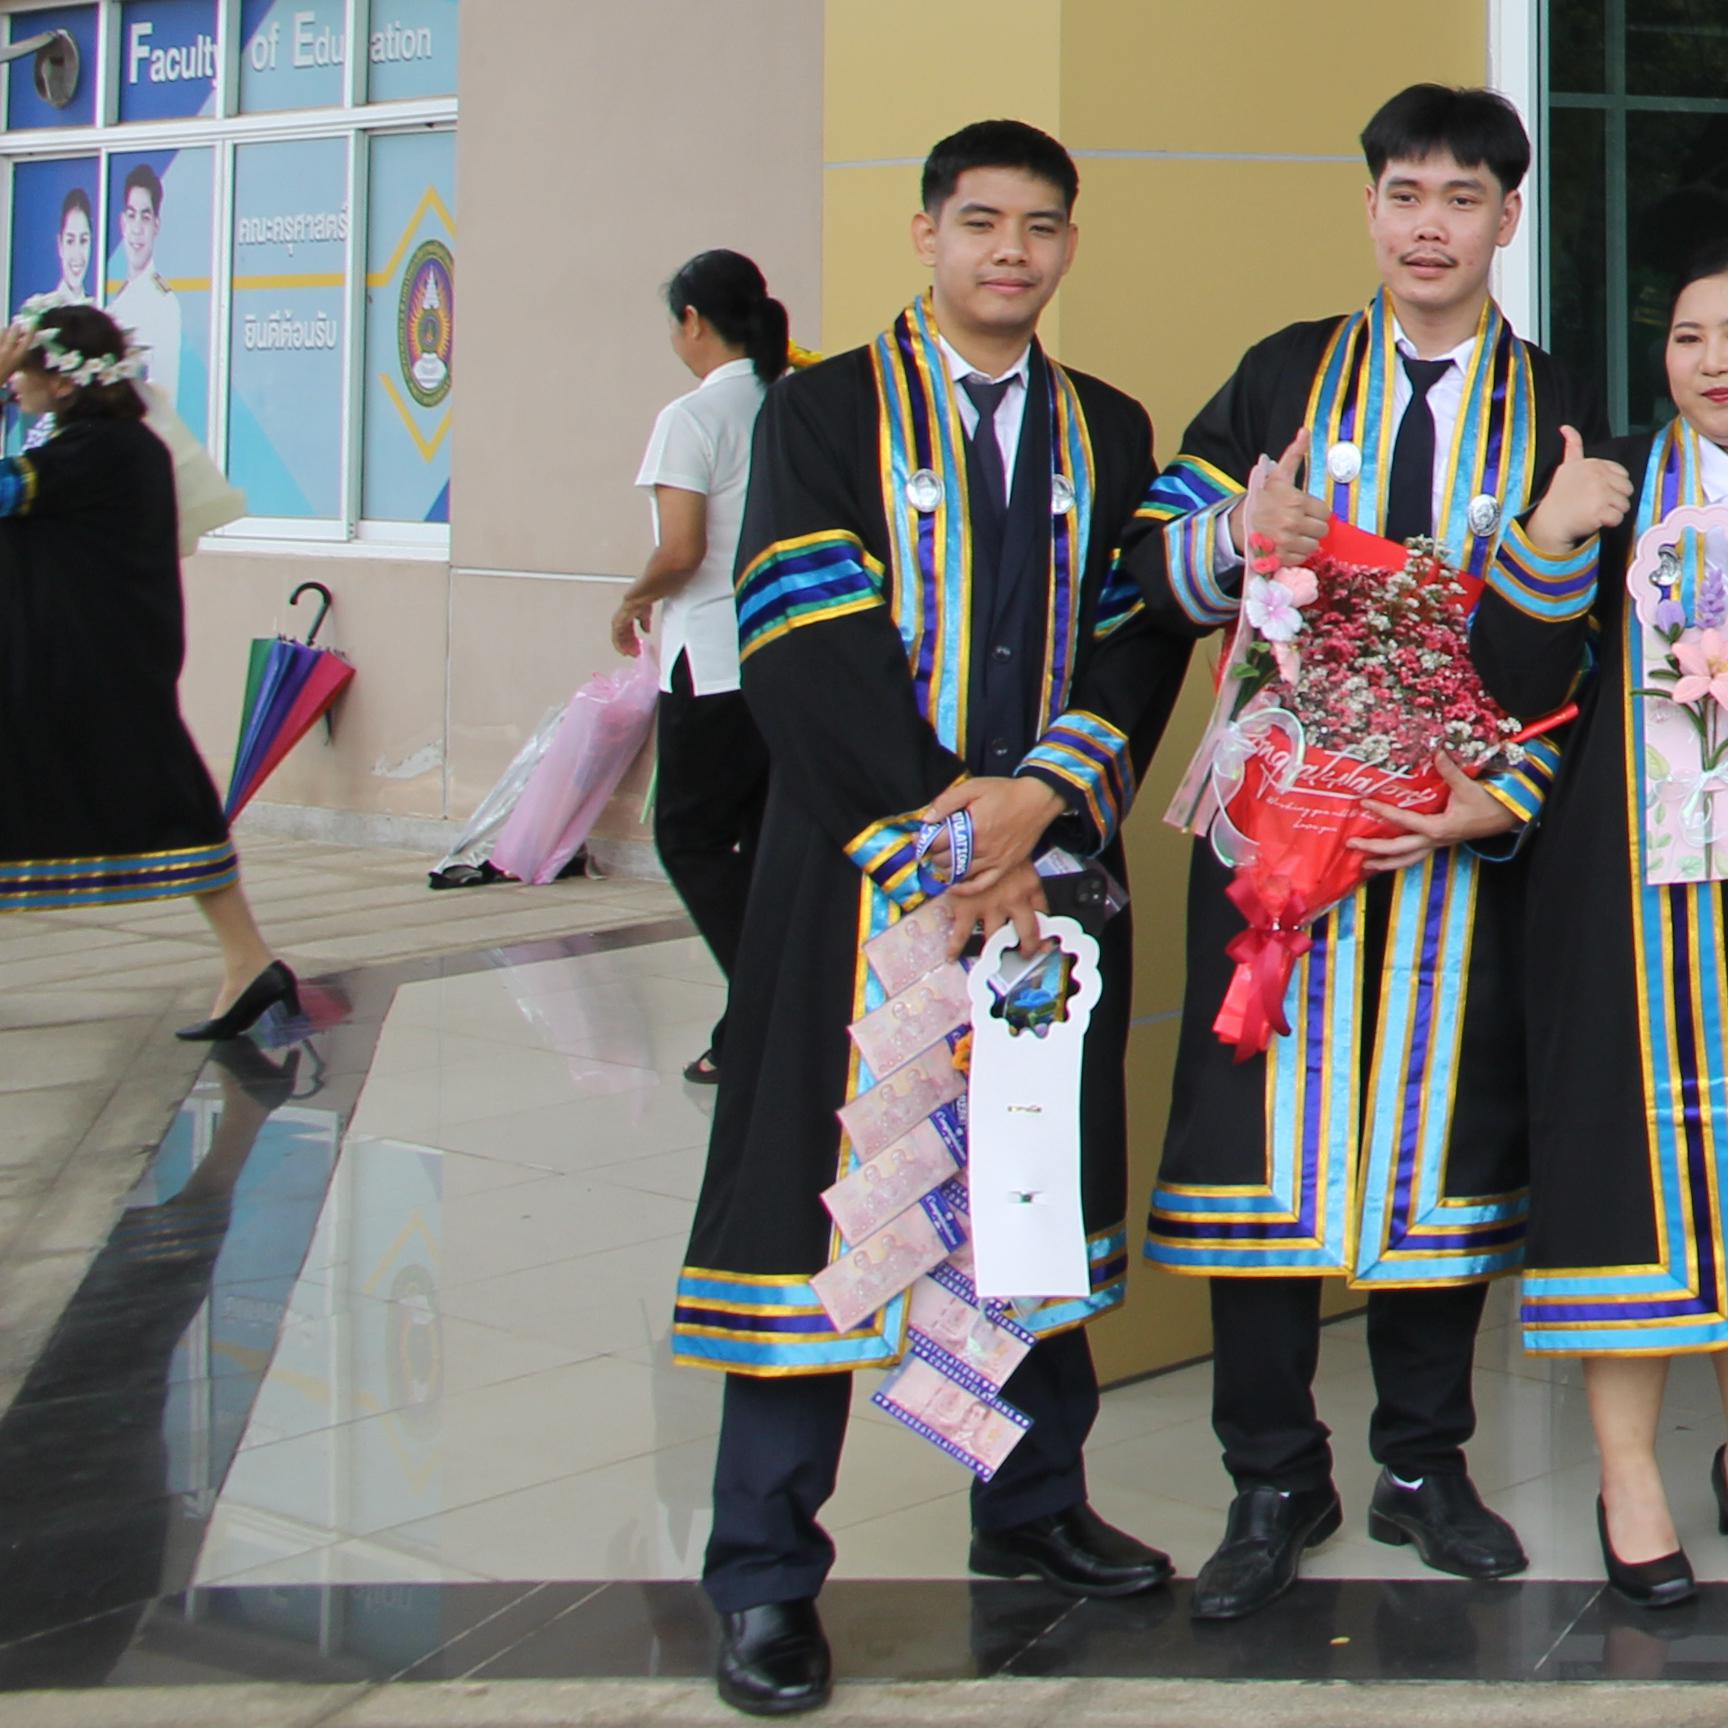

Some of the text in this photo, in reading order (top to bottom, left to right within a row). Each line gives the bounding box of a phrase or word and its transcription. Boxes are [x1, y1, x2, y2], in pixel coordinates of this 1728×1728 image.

[251, 22, 280, 71] of
[293, 11, 432, 69] Eduation
[889, 1403, 976, 1468] CONGRATULATIONS
